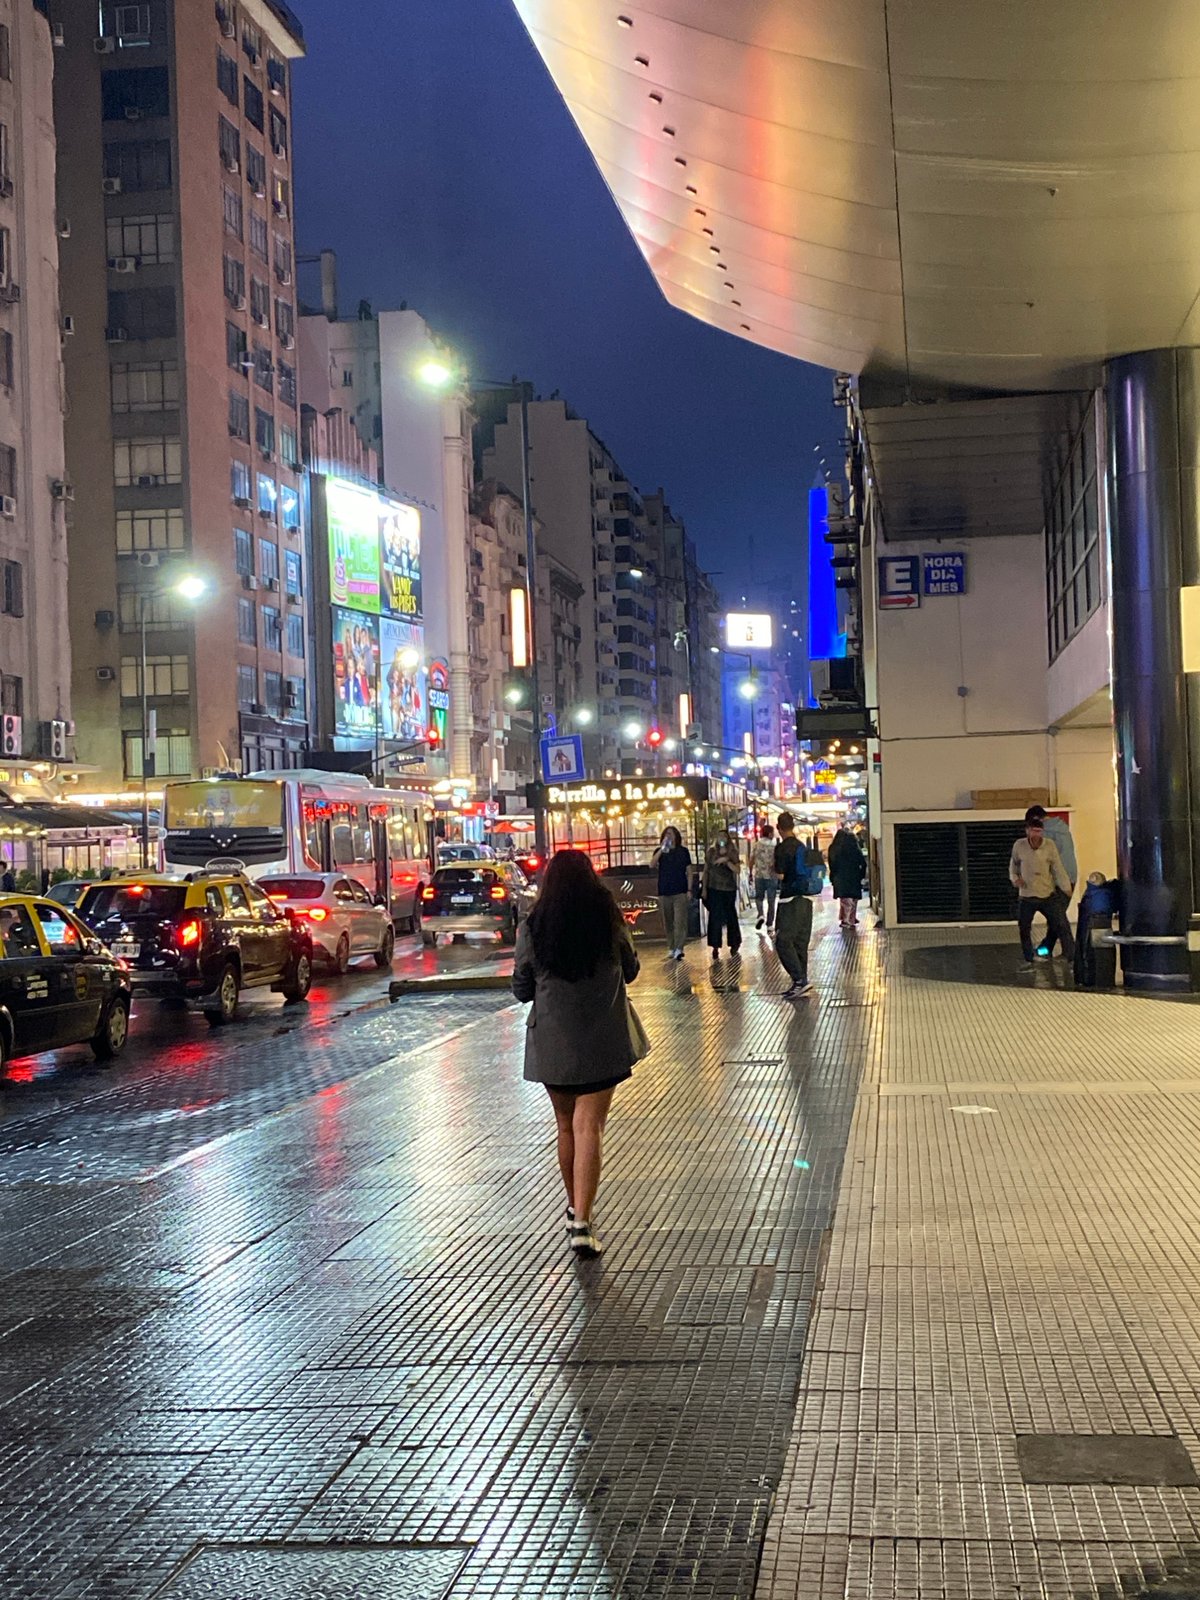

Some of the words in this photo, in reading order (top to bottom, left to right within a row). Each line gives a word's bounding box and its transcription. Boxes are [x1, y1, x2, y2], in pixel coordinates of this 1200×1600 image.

[924, 557, 962, 567] HORA
[886, 561, 912, 592] E
[929, 582, 958, 593] MES
[548, 784, 606, 803] Parrilla
[610, 788, 621, 800] a
[625, 783, 643, 800] la
[646, 782, 686, 799] Leña
[633, 899, 658, 908] AIRES
